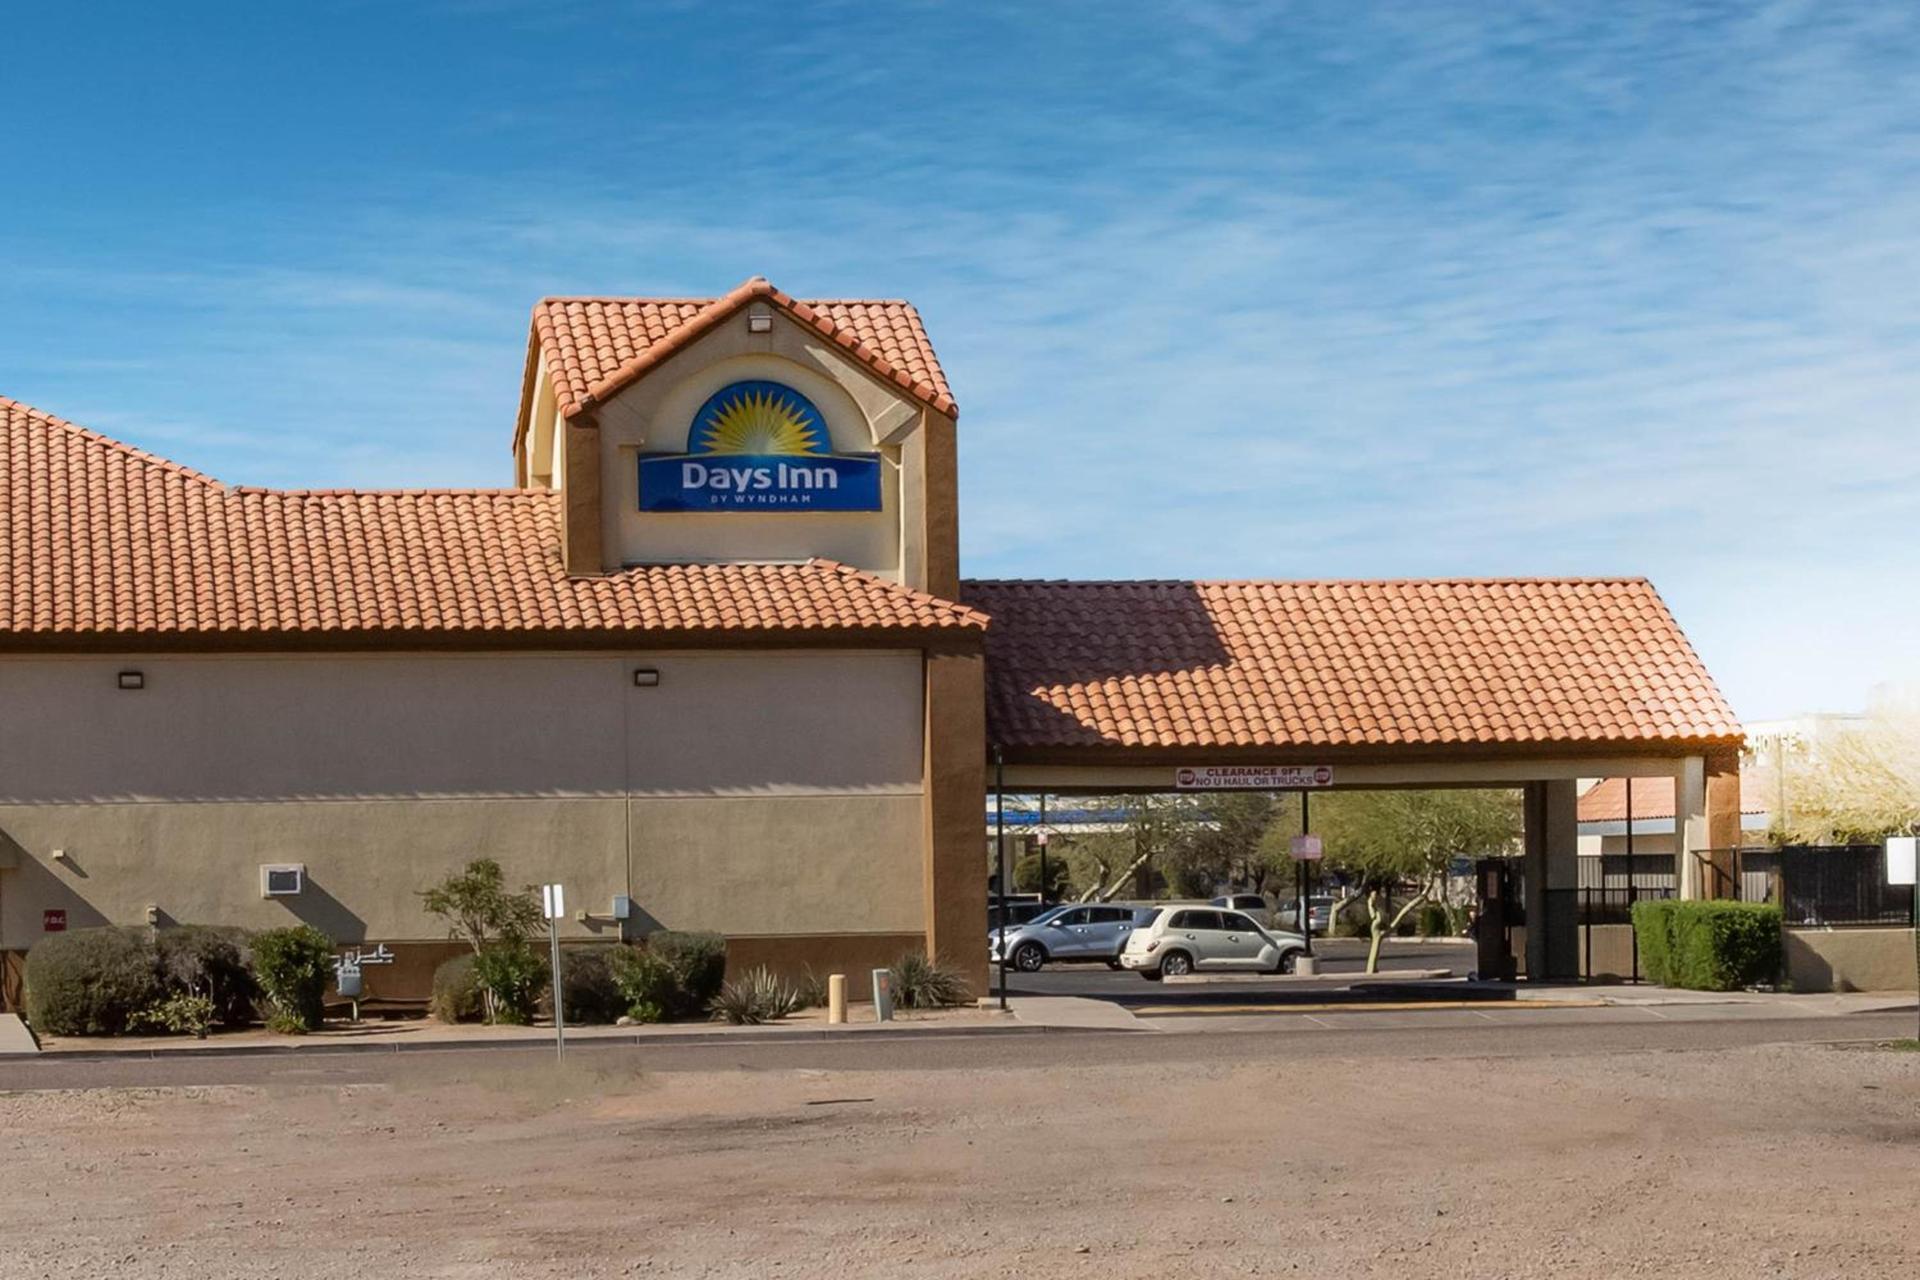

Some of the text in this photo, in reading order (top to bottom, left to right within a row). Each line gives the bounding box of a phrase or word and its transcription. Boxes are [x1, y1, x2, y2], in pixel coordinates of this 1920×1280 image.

[682, 463, 838, 492] Days Inn
[711, 495, 811, 503] BY WYNDHAM
[1206, 767, 1302, 776] CLEARANCE 9FT
[1196, 775, 1313, 786] NO U HAUL OR TRUCKS
